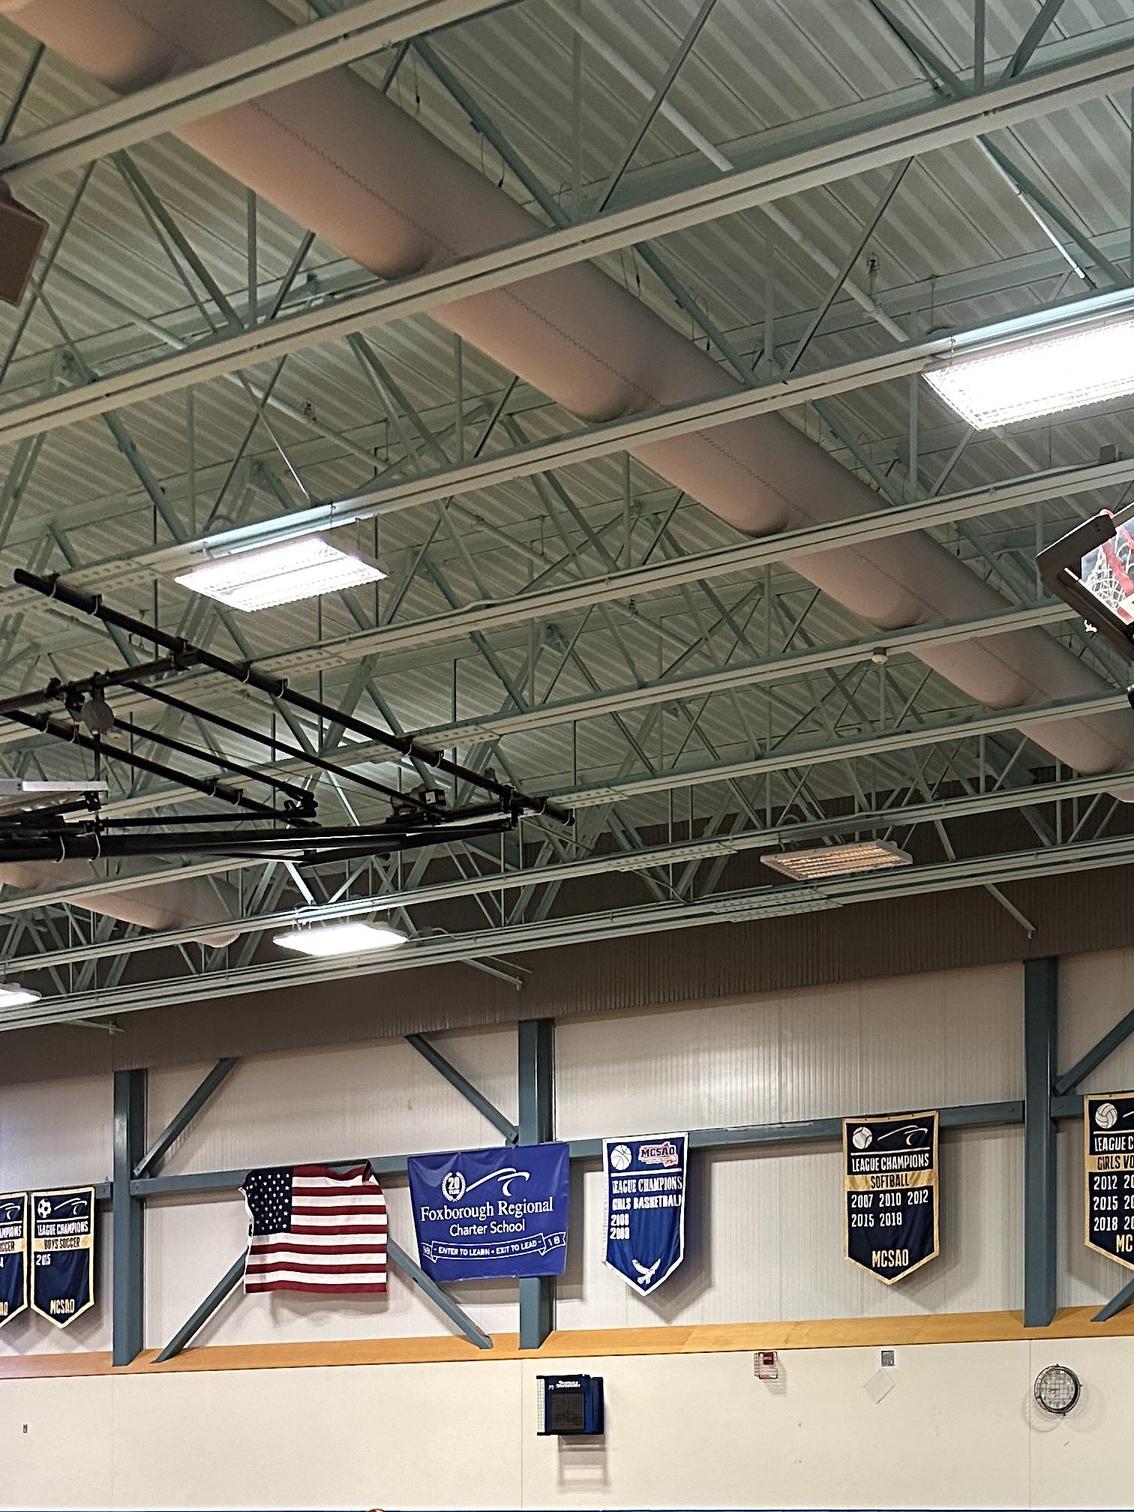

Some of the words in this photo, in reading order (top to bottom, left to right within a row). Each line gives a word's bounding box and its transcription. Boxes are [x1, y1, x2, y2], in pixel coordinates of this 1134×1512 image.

[1094, 1136, 1126, 1151] LEAGUE
[641, 1146, 675, 1158] MCSAO
[852, 1157, 879, 1172] LEAGUE
[881, 1153, 929, 1171] CHAMPIONS
[1097, 1155, 1121, 1171] GIRLS
[448, 1177, 460, 1190] 20
[638, 1176, 683, 1192] CHAMPIONS
[870, 1172, 909, 1189] SOFTBALL
[1093, 1175, 1118, 1190] 2012
[851, 1194, 873, 1208] 2007
[879, 1192, 902, 1207] 2010
[907, 1189, 929, 1205] 2012
[1093, 1195, 1118, 1211] 2015
[420, 1202, 494, 1222] Foxborough
[498, 1197, 553, 1218] Regional
[851, 1213, 874, 1227] 2015
[880, 1211, 902, 1226] 2018
[1094, 1216, 1118, 1231] 2018
[37, 1224, 56, 1236] LEAGUE
[57, 1221, 89, 1235] CHAMPIONS
[450, 1224, 487, 1237] Charter
[490, 1219, 525, 1234] School
[44, 1239, 59, 1250] BOYS
[60, 1237, 80, 1249] SOCCER
[439, 1246, 459, 1256] ENTER
[460, 1248, 469, 1257] TO
[469, 1248, 490, 1257] LEARN
[496, 1246, 509, 1255] EXIT
[511, 1244, 519, 1252] TO
[521, 1240, 537, 1250] LEAD
[548, 1236, 560, 1246] 18
[872, 1249, 909, 1267] MCSAO
[50, 1299, 75, 1315] MCSAO
